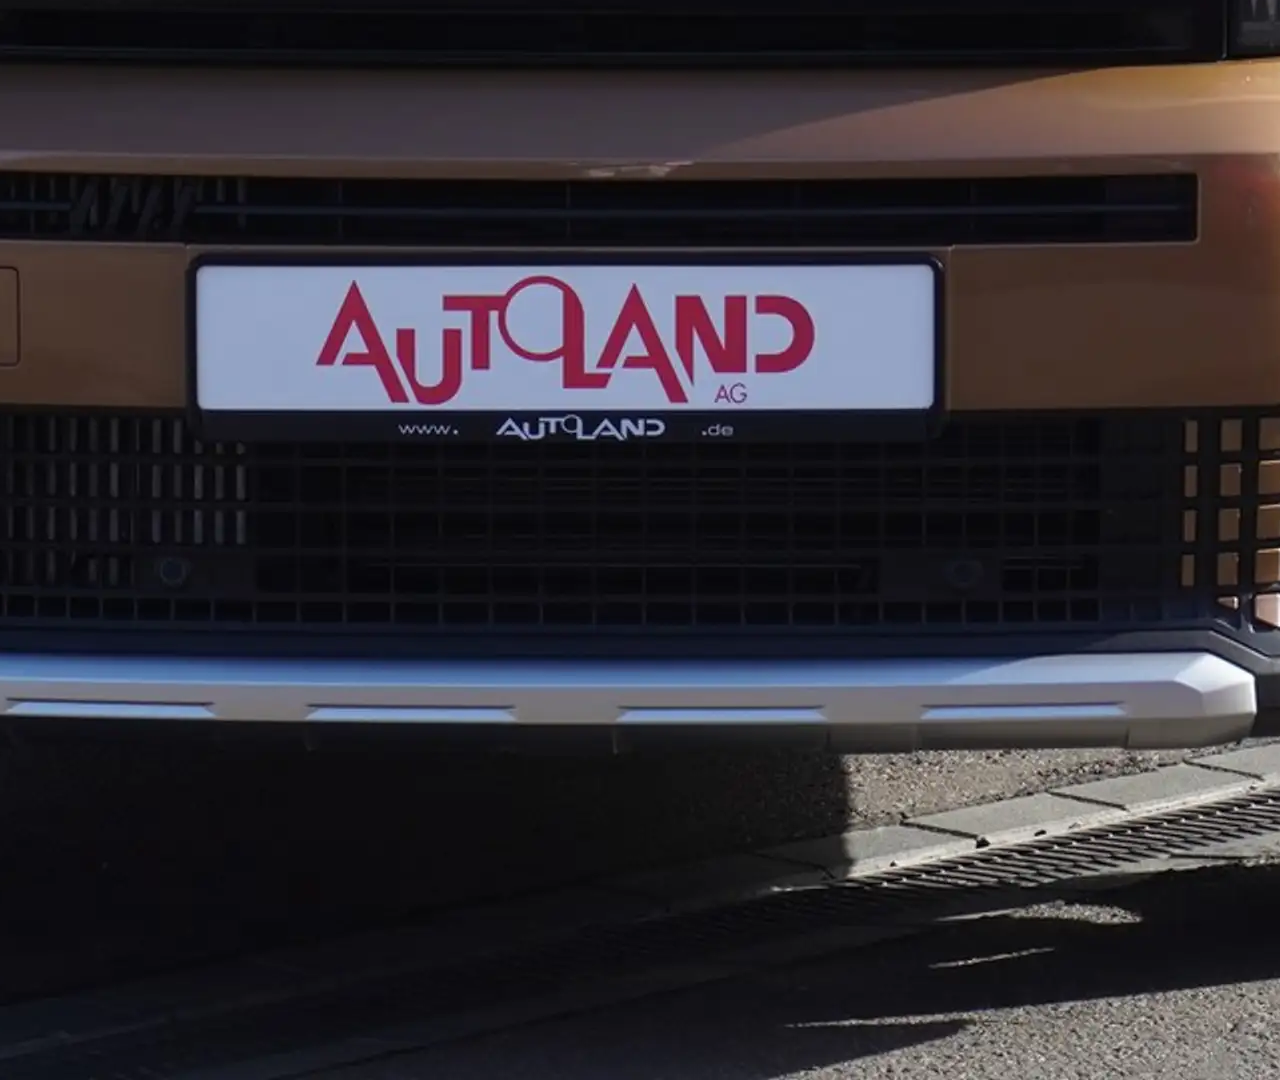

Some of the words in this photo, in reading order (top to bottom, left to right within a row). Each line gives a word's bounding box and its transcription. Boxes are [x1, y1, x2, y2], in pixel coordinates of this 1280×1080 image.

[316, 275, 816, 405] AUTOLAND
[713, 382, 748, 404] AG
[398, 424, 460, 436] www.
[495, 414, 666, 441] AUTOLAND
[701, 423, 734, 437] .de
